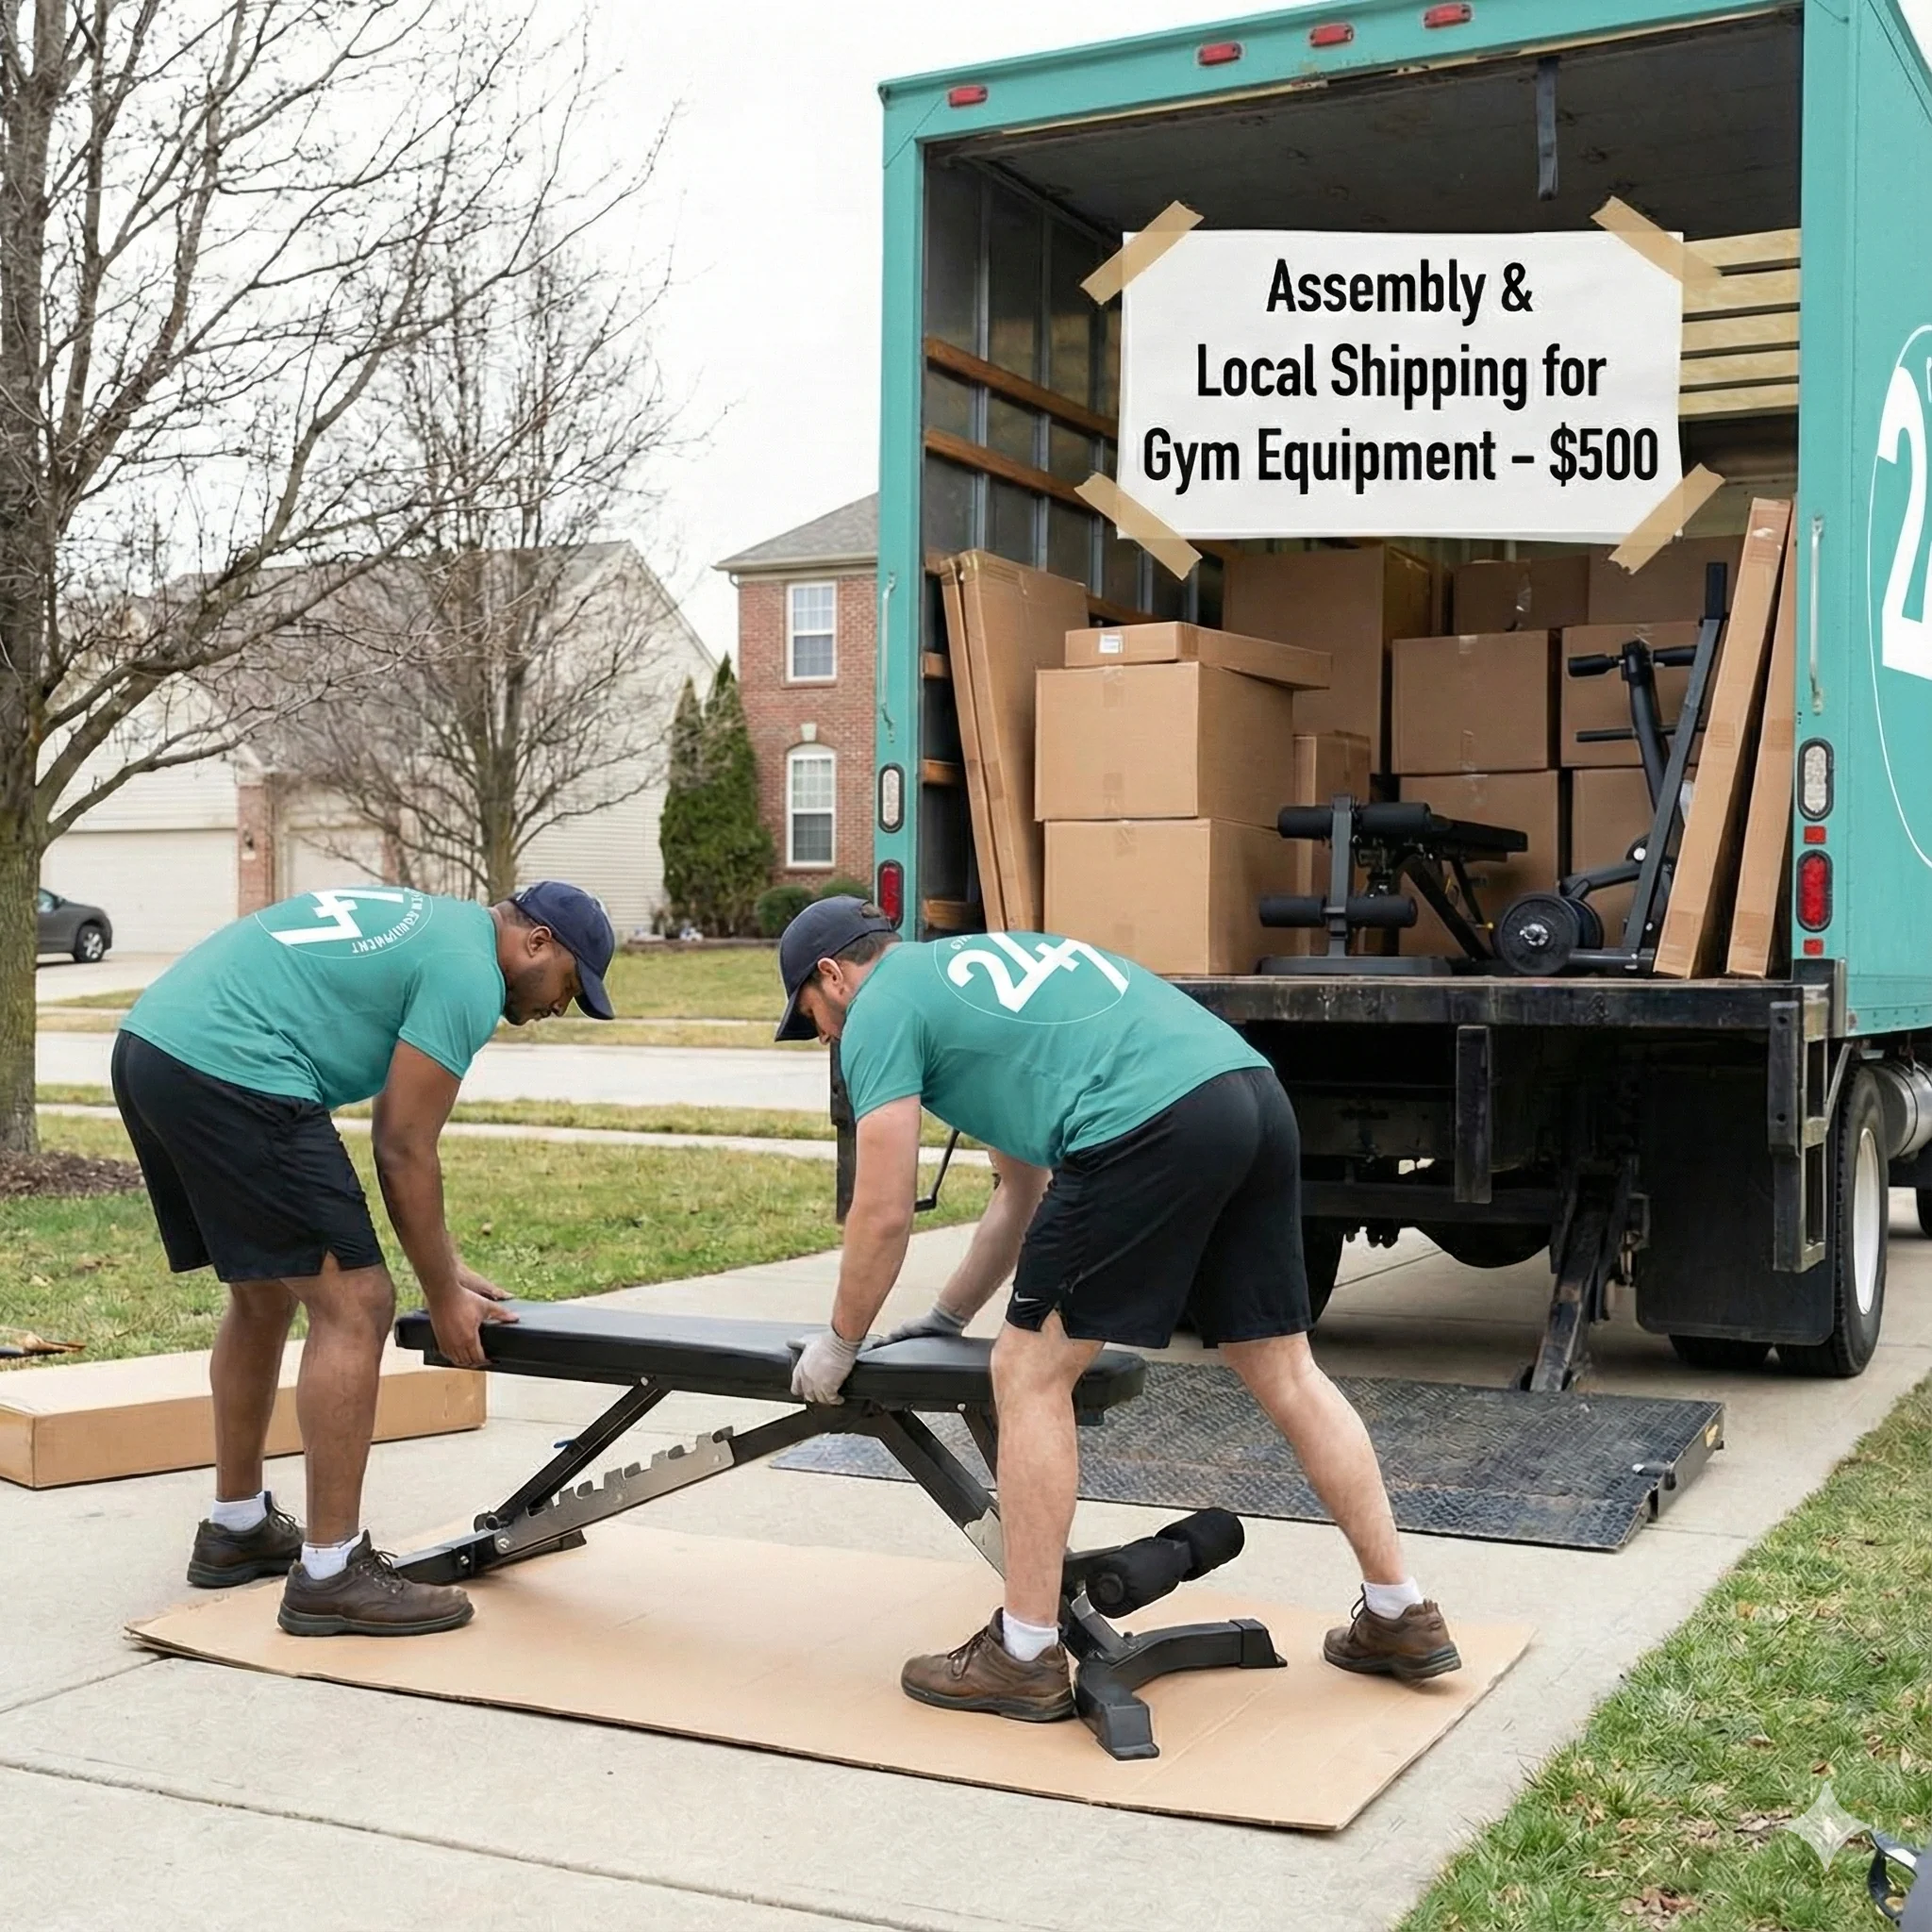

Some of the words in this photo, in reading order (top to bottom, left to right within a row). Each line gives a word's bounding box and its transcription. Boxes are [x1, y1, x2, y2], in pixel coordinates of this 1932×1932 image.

[1266, 258, 1488, 327] Assembly
[1501, 261, 1534, 312] &
[1197, 343, 1318, 397] Local
[1330, 342, 1527, 411] Shipping
[1541, 342, 1607, 397] for
[1143, 426, 1240, 495] Gym
[1257, 427, 1496, 495] Equipment
[1549, 422, 1658, 488] $500
